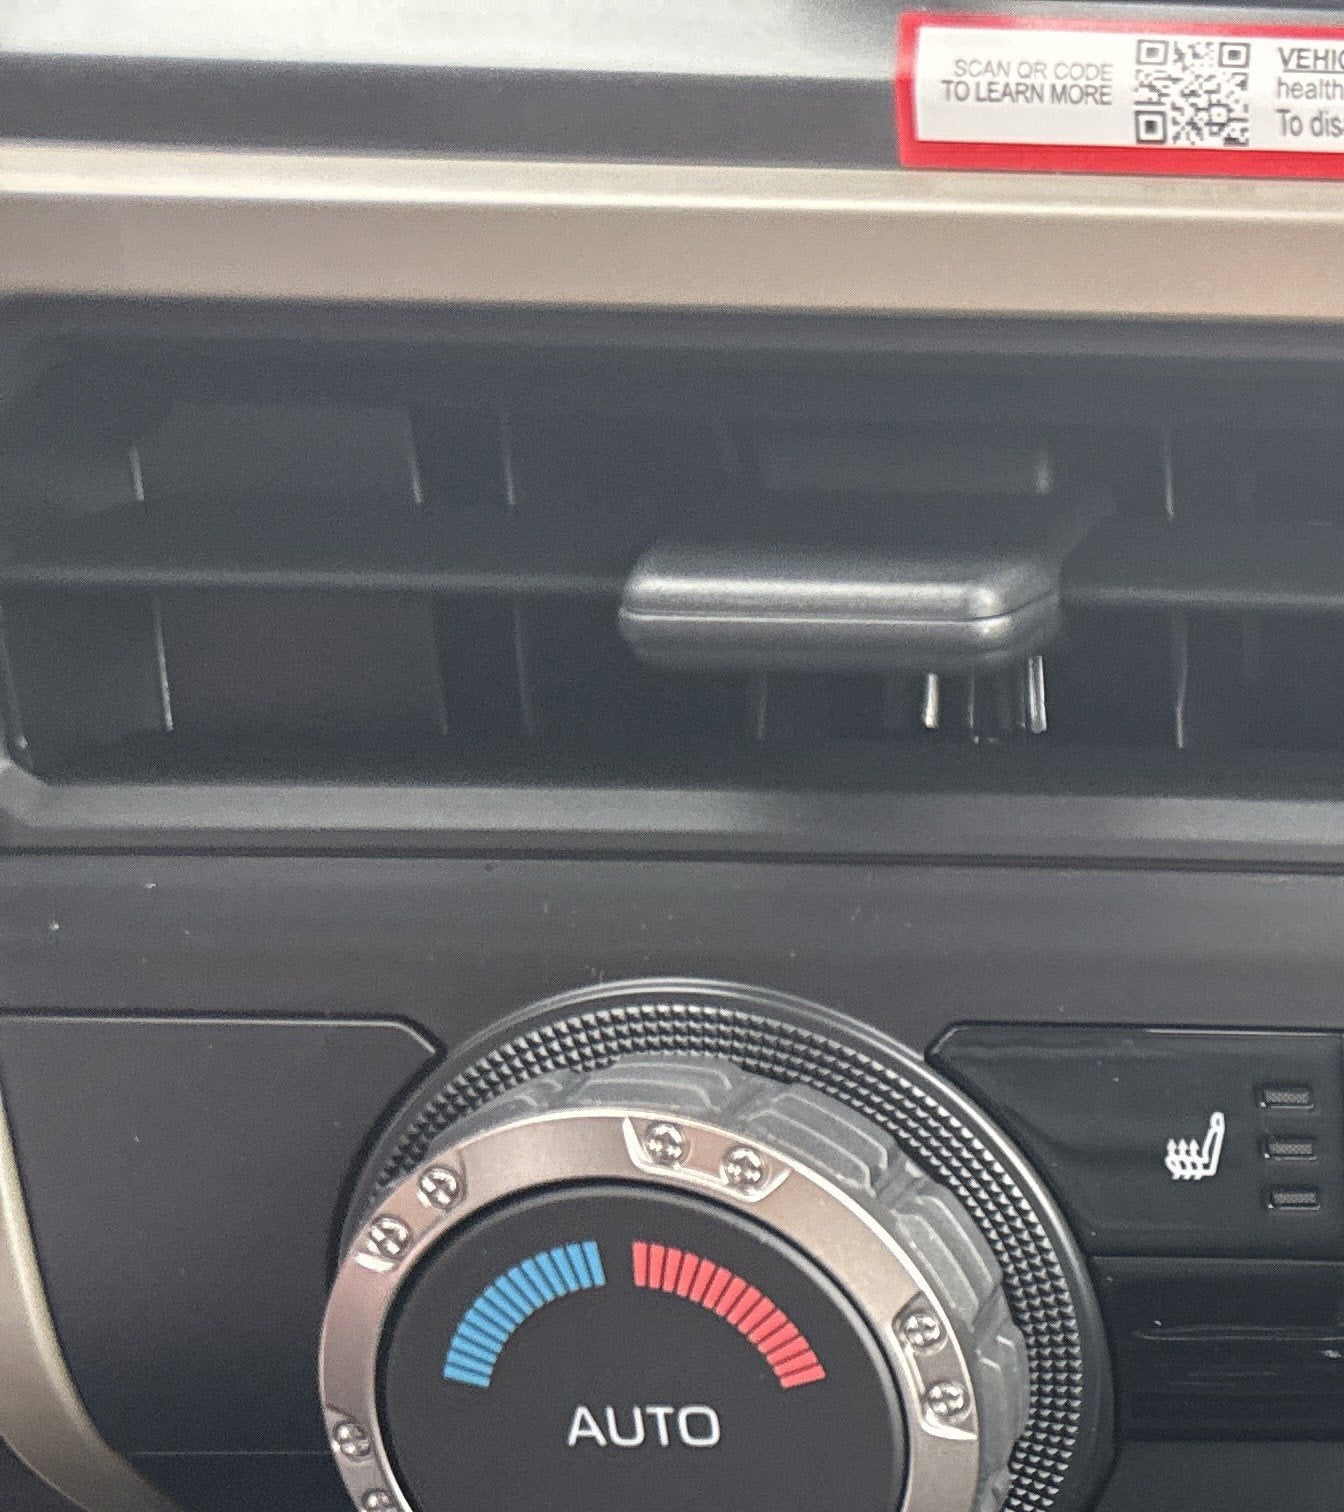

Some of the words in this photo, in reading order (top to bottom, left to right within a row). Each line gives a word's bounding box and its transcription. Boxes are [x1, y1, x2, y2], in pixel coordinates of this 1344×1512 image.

[954, 58, 1011, 79] SCAN
[1017, 61, 1048, 80] QR
[1054, 62, 1114, 82] CODE
[941, 80, 971, 102] TO
[975, 81, 1045, 104] LEARN
[1051, 83, 1113, 106] MORE
[1276, 77, 1344, 101] health
[1276, 108, 1302, 137] To
[567, 1404, 721, 1448] AUTO
